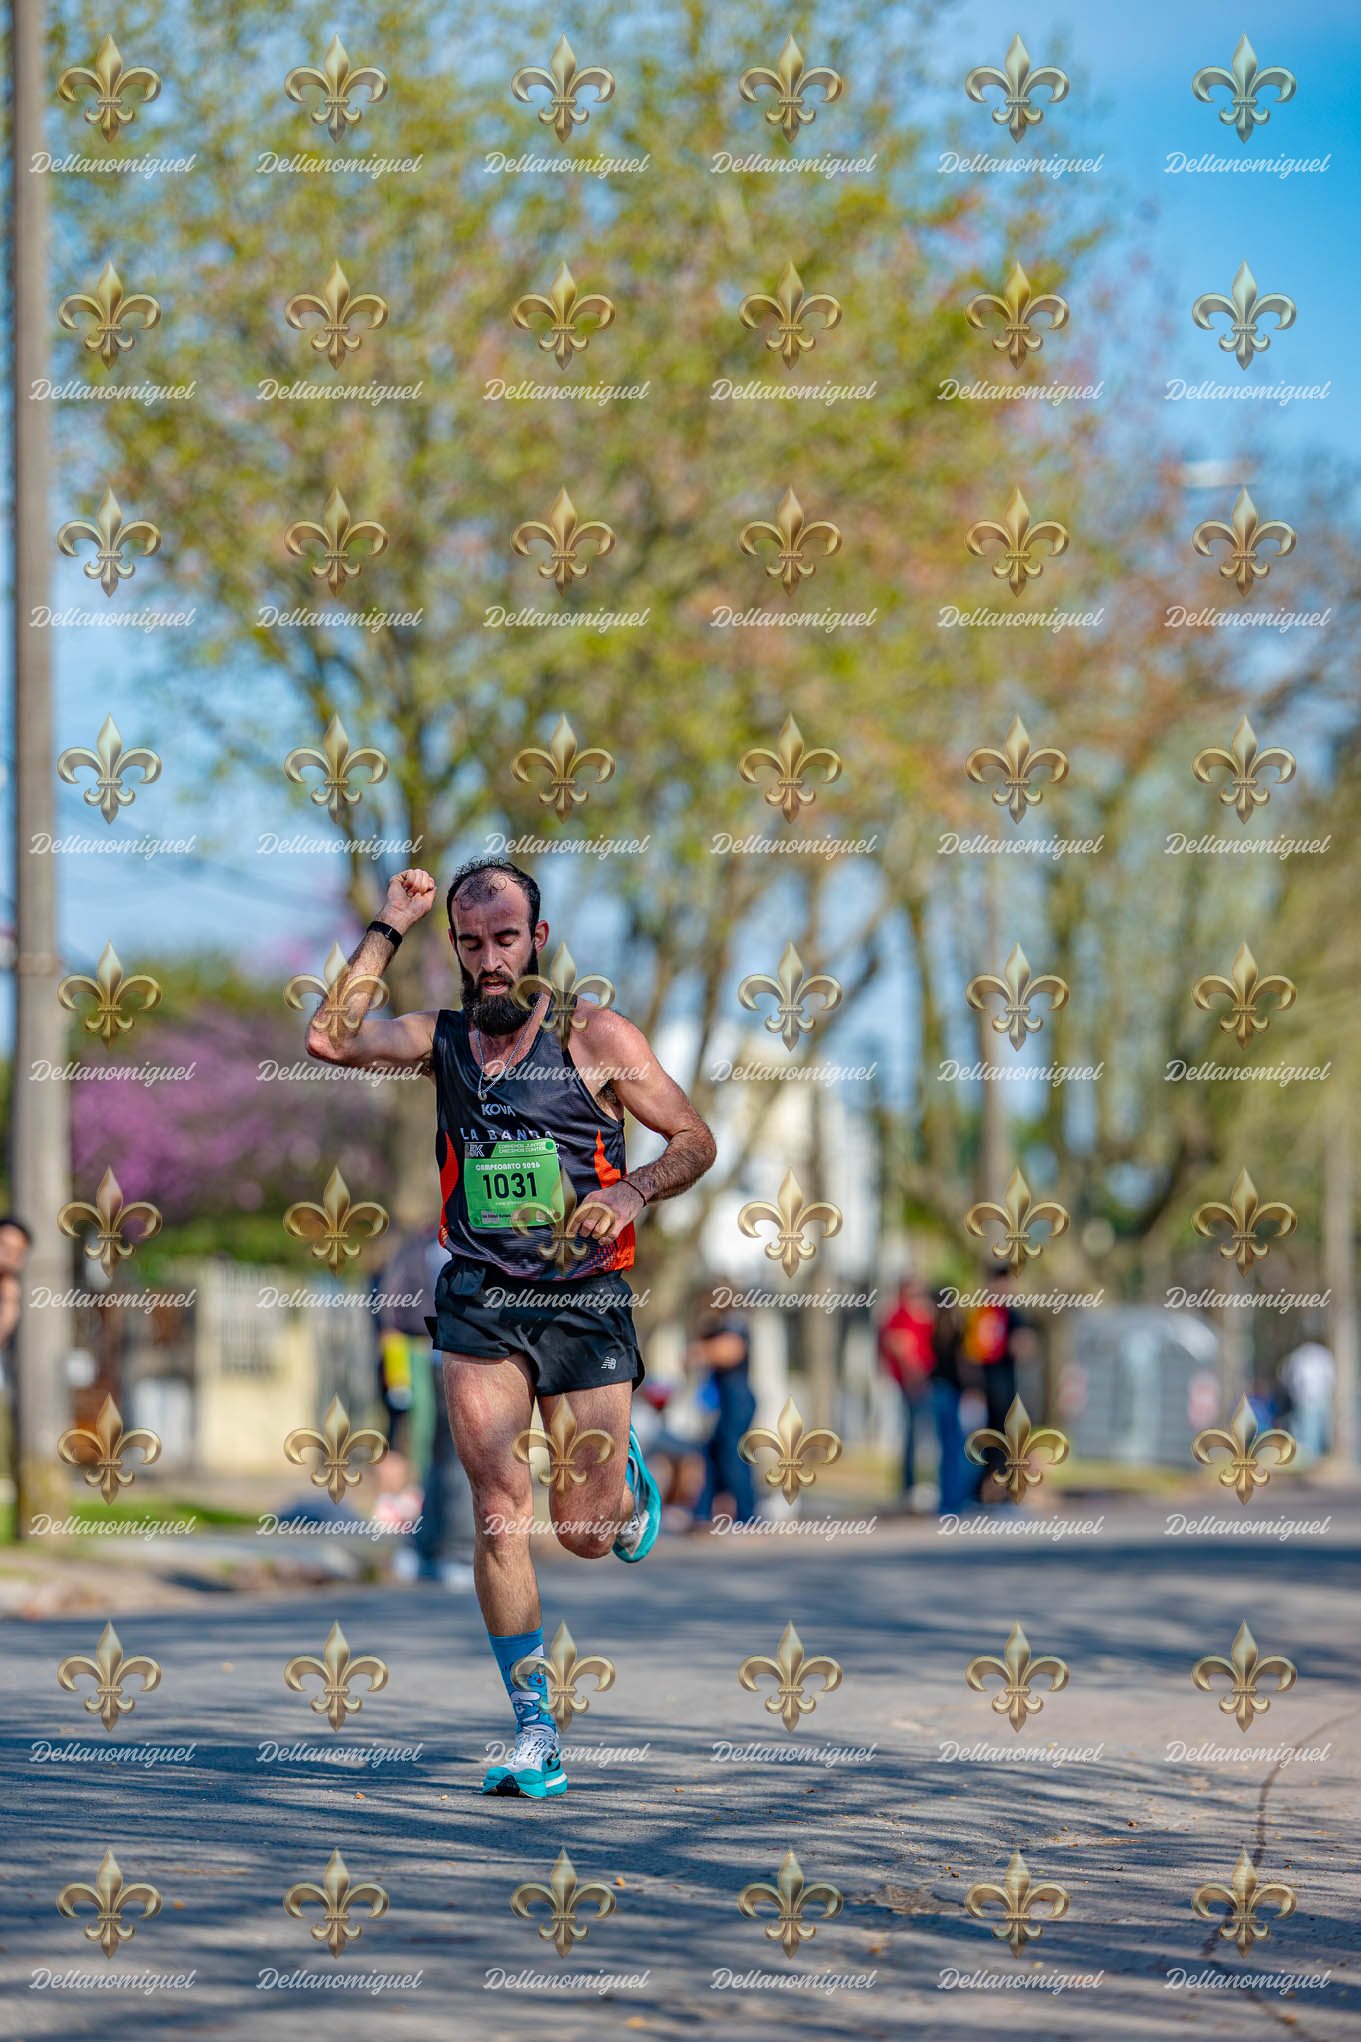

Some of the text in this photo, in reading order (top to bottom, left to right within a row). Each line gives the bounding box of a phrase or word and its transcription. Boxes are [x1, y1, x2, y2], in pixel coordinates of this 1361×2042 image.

[481, 1103, 517, 1117] KOVA
[460, 1127, 479, 1141] LA
[475, 1163, 521, 1172] CAMPEONATO
[482, 1171, 538, 1200] 1031
